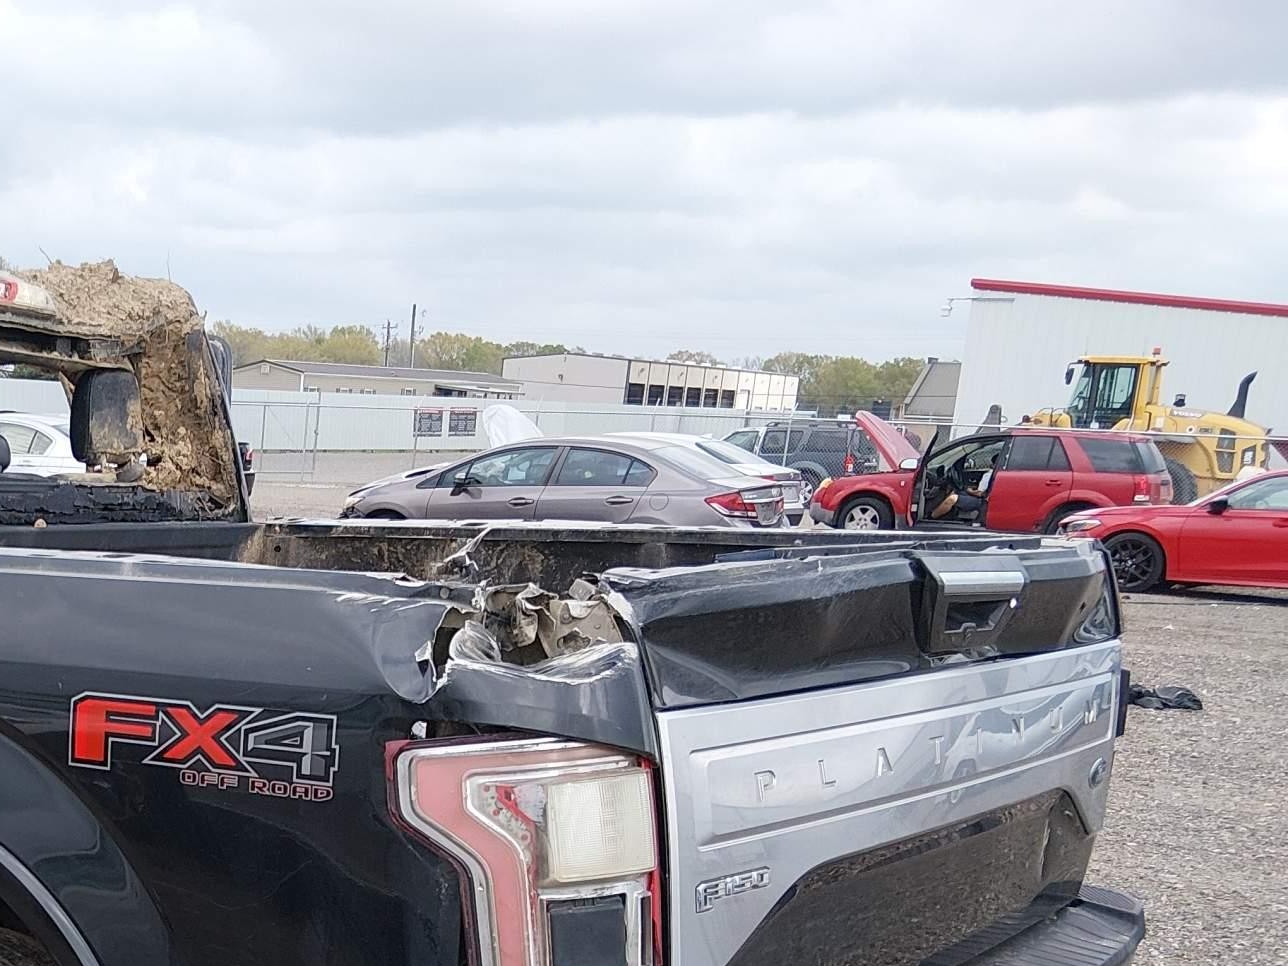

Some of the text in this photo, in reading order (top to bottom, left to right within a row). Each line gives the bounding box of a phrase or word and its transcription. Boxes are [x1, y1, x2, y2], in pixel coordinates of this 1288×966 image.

[69, 691, 339, 787] FX4
[179, 769, 334, 802] OFF ROAD
[754, 697, 1099, 801] PLATINUM
